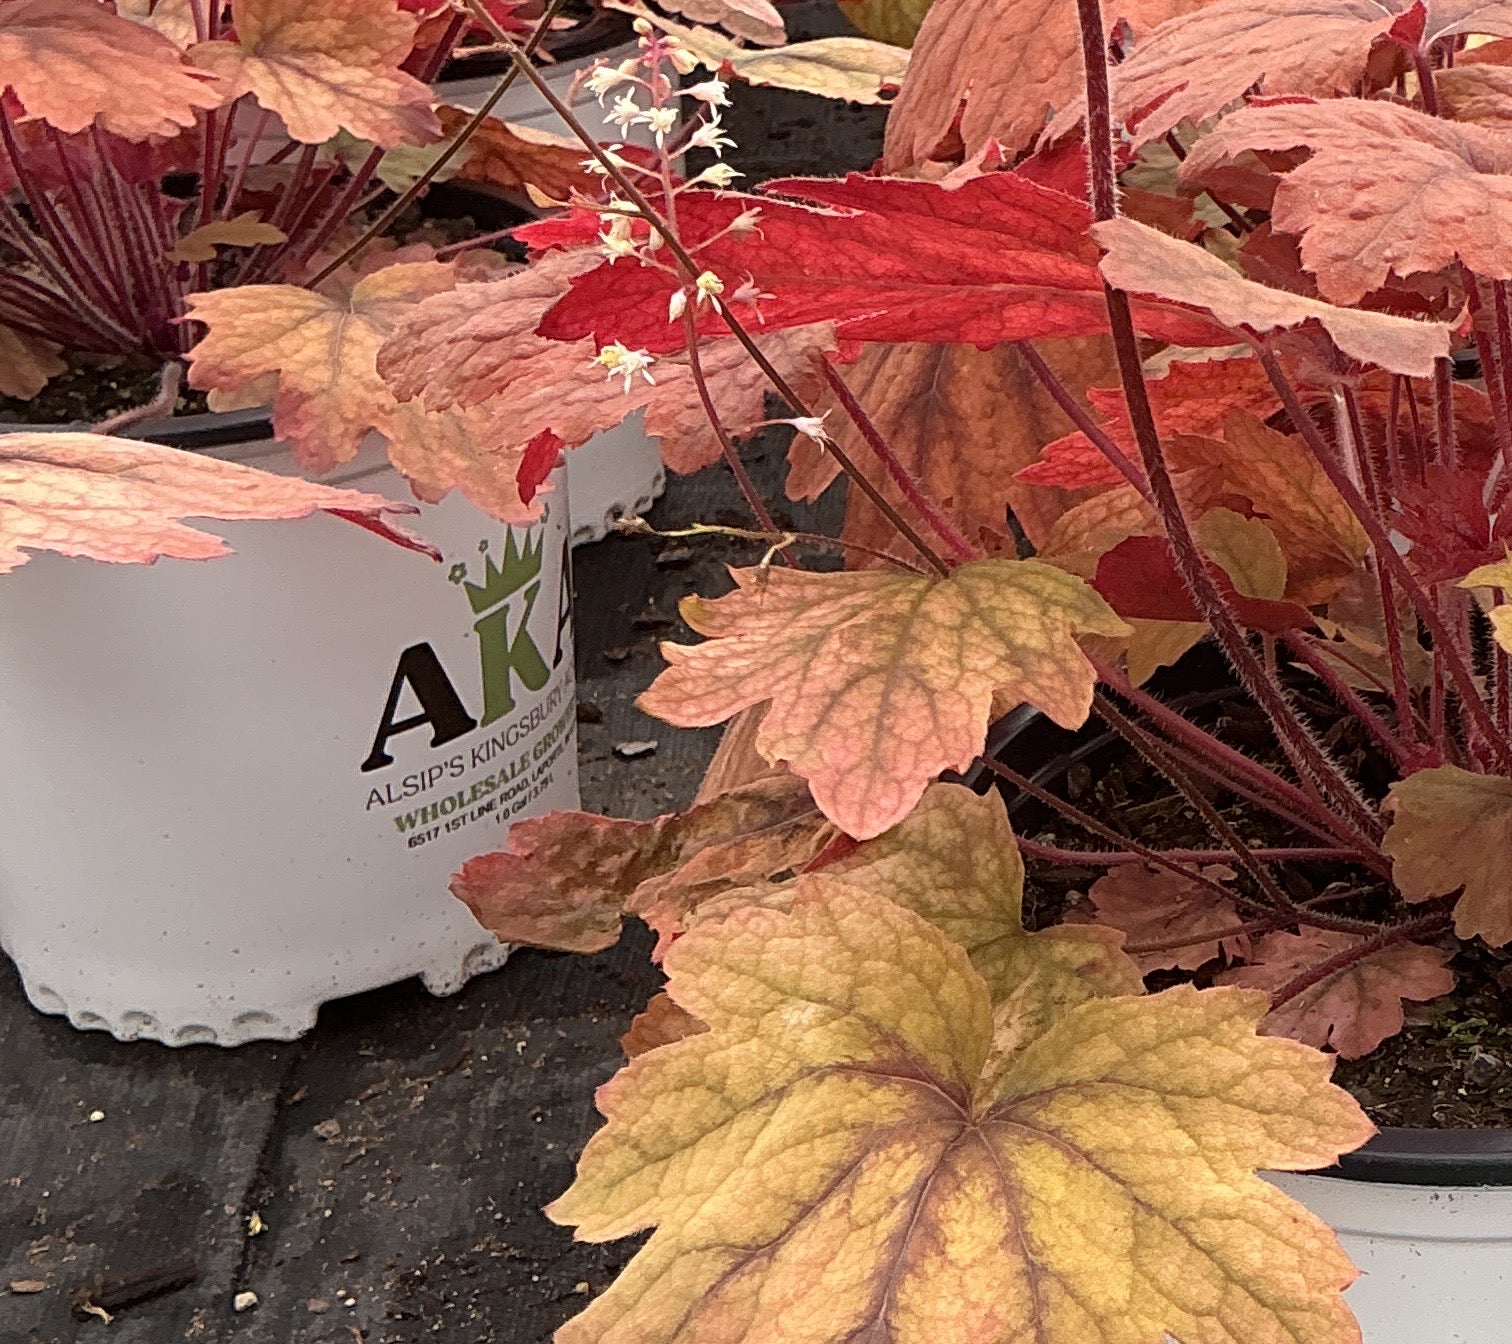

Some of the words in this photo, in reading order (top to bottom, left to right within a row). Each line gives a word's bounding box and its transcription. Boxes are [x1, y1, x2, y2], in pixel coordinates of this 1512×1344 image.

[366, 756, 465, 810] ALSIP'S
[394, 749, 530, 833] WHOLESALE
[408, 827, 440, 848] 6517
[470, 799, 497, 822] LINE
